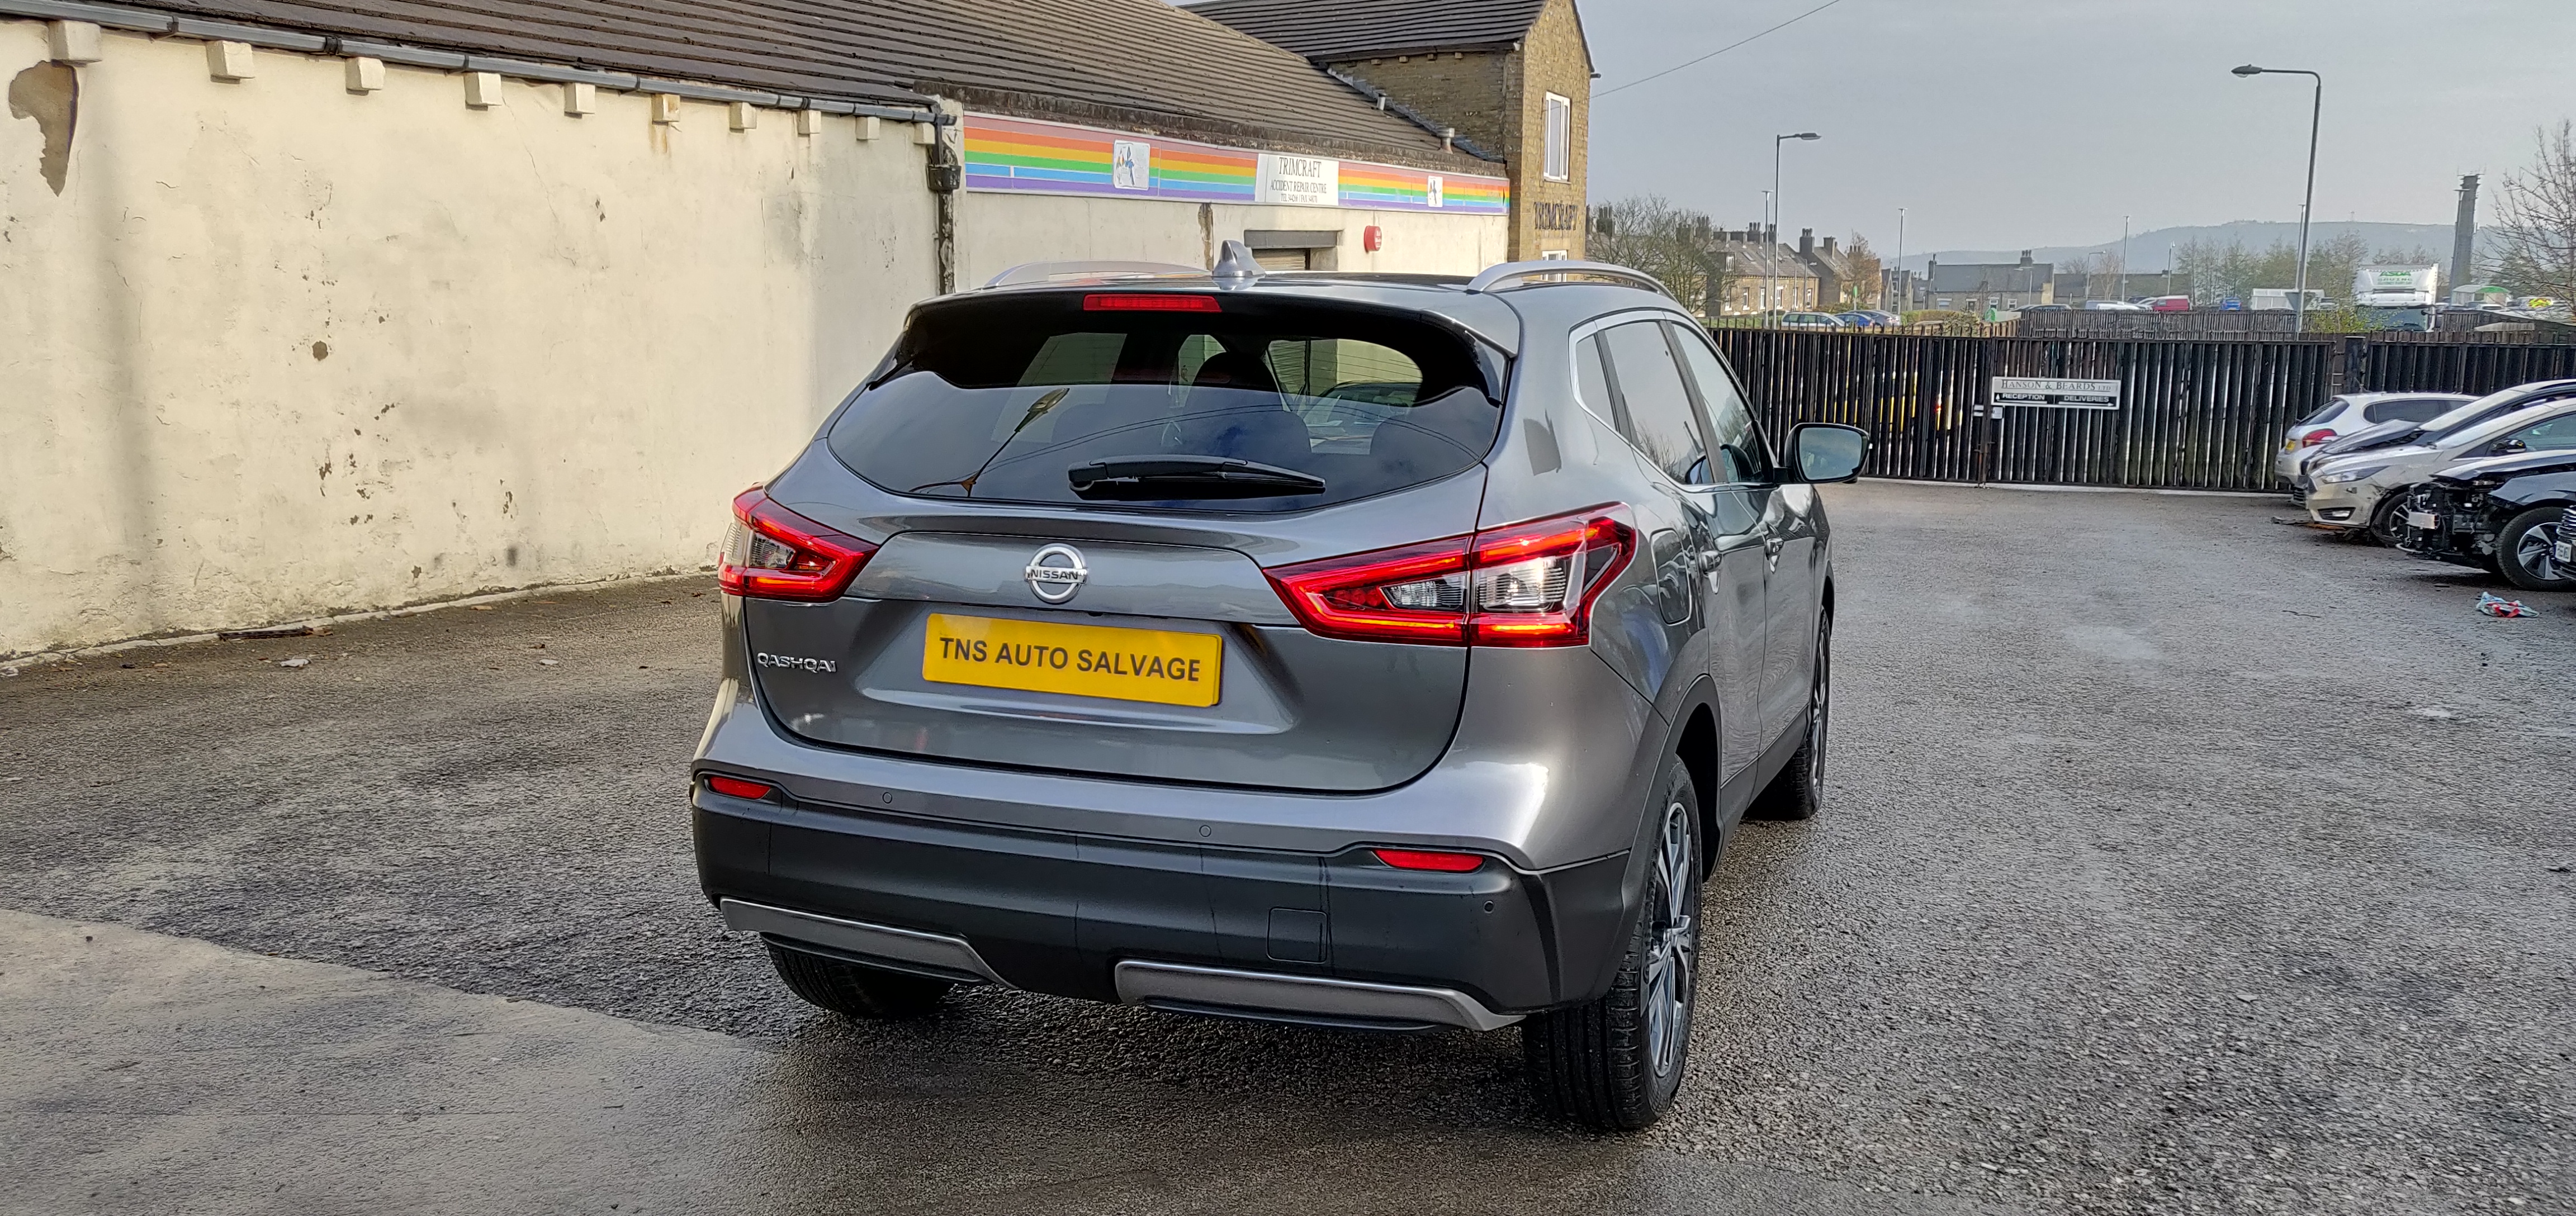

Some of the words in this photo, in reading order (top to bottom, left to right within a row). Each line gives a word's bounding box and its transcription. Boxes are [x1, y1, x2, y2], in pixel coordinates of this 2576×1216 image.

[1278, 156, 1322, 178] TRIMCRAFT
[1270, 179, 1293, 192] ACCIDENT
[1293, 181, 1310, 193] REPAIR
[1310, 183, 1327, 194] CENTRE
[1533, 202, 1578, 230] TRIMCRAFT
[2056, 382, 2095, 391] BEARDS
[1031, 569, 1078, 580] NISSAN
[757, 652, 837, 673] QASHQAI
[939, 637, 988, 662] TNS
[995, 643, 1068, 669] AUTO
[1077, 649, 1201, 682] SALVAGE
